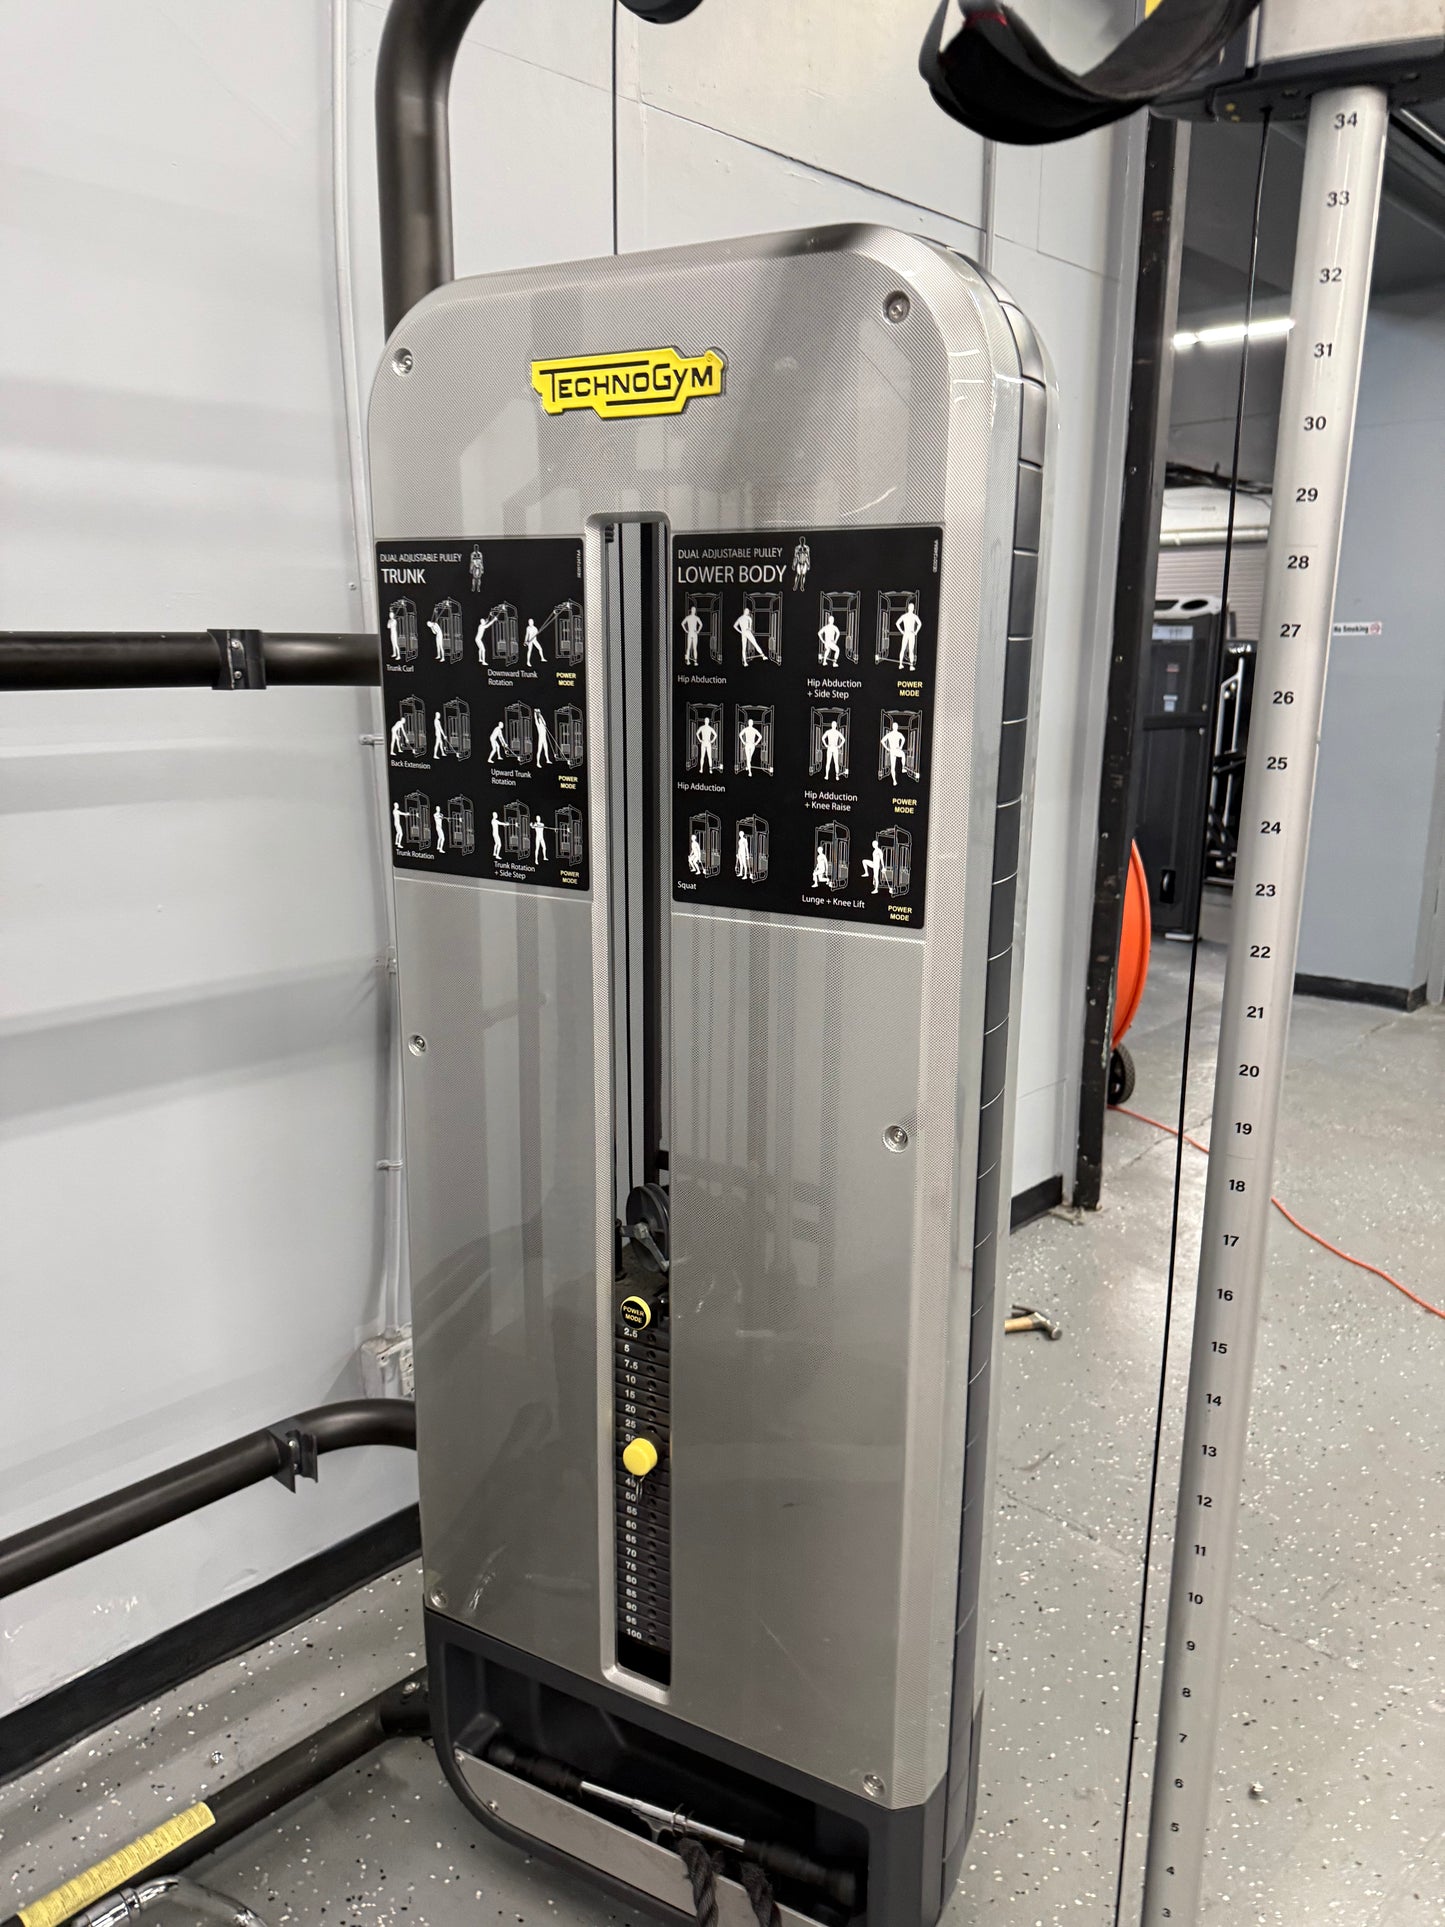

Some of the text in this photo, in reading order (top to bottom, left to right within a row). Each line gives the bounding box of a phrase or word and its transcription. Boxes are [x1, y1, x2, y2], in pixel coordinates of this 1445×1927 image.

[1333, 113, 1357, 129] 34
[1326, 191, 1349, 207] 33
[1319, 268, 1341, 283] 32
[1313, 343, 1332, 357] 31
[1303, 417, 1326, 430] 30
[1295, 488, 1318, 502] 29
[380, 553, 462, 562] DUAL ADJUSTABLE PULLEY
[678, 548, 782, 559] DUAL ADJUSTABLE PULLEY
[1287, 555, 1309, 569] 28
[381, 569, 425, 583] TRUNK
[678, 565, 786, 583] LOWER BODY
[1279, 624, 1301, 637] 27
[1343, 624, 1369, 635] Smoking
[488, 669, 537, 678] Downward Trunk
[488, 678, 513, 686] Rotation
[678, 675, 726, 684] Hip Abduction
[807, 679, 861, 688] Hip Abduction
[815, 689, 830, 698] Side
[832, 690, 849, 700] Step
[1272, 691, 1293, 704] 26
[404, 761, 430, 769] Extension
[1266, 757, 1287, 769] 25
[491, 769, 531, 778] Upward Trunk
[492, 777, 516, 785] Rotation
[678, 782, 725, 792] Hip Adduction
[804, 791, 857, 801] Hip Adduction
[812, 801, 830, 809] Knee
[832, 803, 851, 811] Raise
[1260, 821, 1280, 834] 24
[411, 851, 434, 859] Rotation
[510, 862, 535, 871] Rotation
[513, 871, 526, 880] Step
[678, 881, 696, 889] Squat
[1255, 884, 1275, 896] 23
[802, 895, 824, 905] Lunge
[833, 898, 851, 907] Knee
[853, 900, 864, 908] Lift
[888, 905, 912, 913] POWER
[1249, 946, 1270, 958] 22
[1246, 1006, 1263, 1018] 21
[1238, 1064, 1259, 1077] 20
[1235, 1122, 1252, 1134] 19
[1228, 1180, 1245, 1192] 18
[1223, 1235, 1239, 1246] 17
[1216, 1289, 1232, 1301] 16
[623, 1305, 645, 1317] POWER
[626, 1313, 642, 1323] MODE
[1211, 1342, 1227, 1354] 15
[1205, 1394, 1221, 1406] 14
[1201, 1445, 1216, 1457] 13
[1196, 1495, 1212, 1507] 12
[1194, 1545, 1205, 1556] 11
[1188, 1592, 1203, 1604] 10
[1186, 1641, 1195, 1650] 9
[1182, 1688, 1190, 1697] 8
[1178, 1733, 1187, 1742] 7
[1174, 1779, 1183, 1788] 6
[1170, 1823, 1178, 1832] 5
[1162, 1908, 1170, 1917] 3
